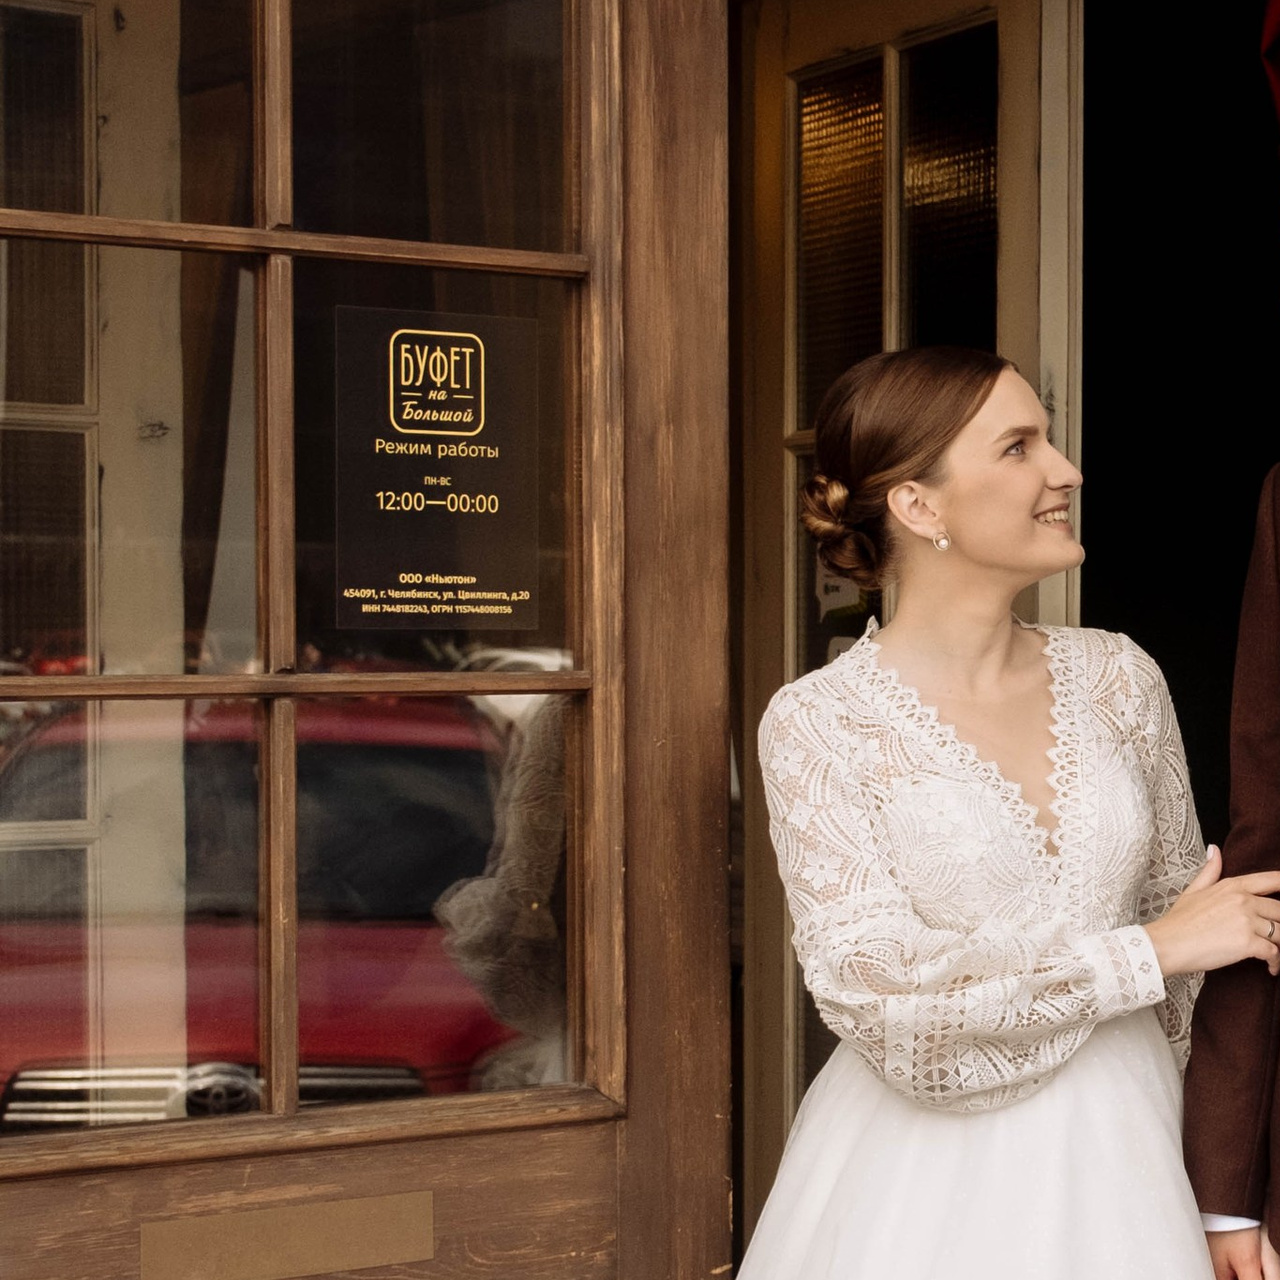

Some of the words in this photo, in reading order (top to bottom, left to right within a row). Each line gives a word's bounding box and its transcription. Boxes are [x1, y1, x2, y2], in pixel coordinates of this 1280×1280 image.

[400, 344, 475, 389] БУФЕТ
[428, 390, 448, 401] на
[402, 401, 474, 423] Большой
[375, 439, 432, 455] Режим
[437, 442, 499, 459] работы
[399, 573, 423, 584] ООО
[424, 574, 477, 584] «Ньютон»
[343, 588, 378, 600] 454091,
[380, 590, 387, 598] г.
[387, 589, 441, 600] Челябинск,
[442, 591, 456, 601] ул.
[458, 590, 510, 601] Цвиллинга,
[362, 604, 381, 613] ИНН
[431, 605, 453, 613] ОГРН
